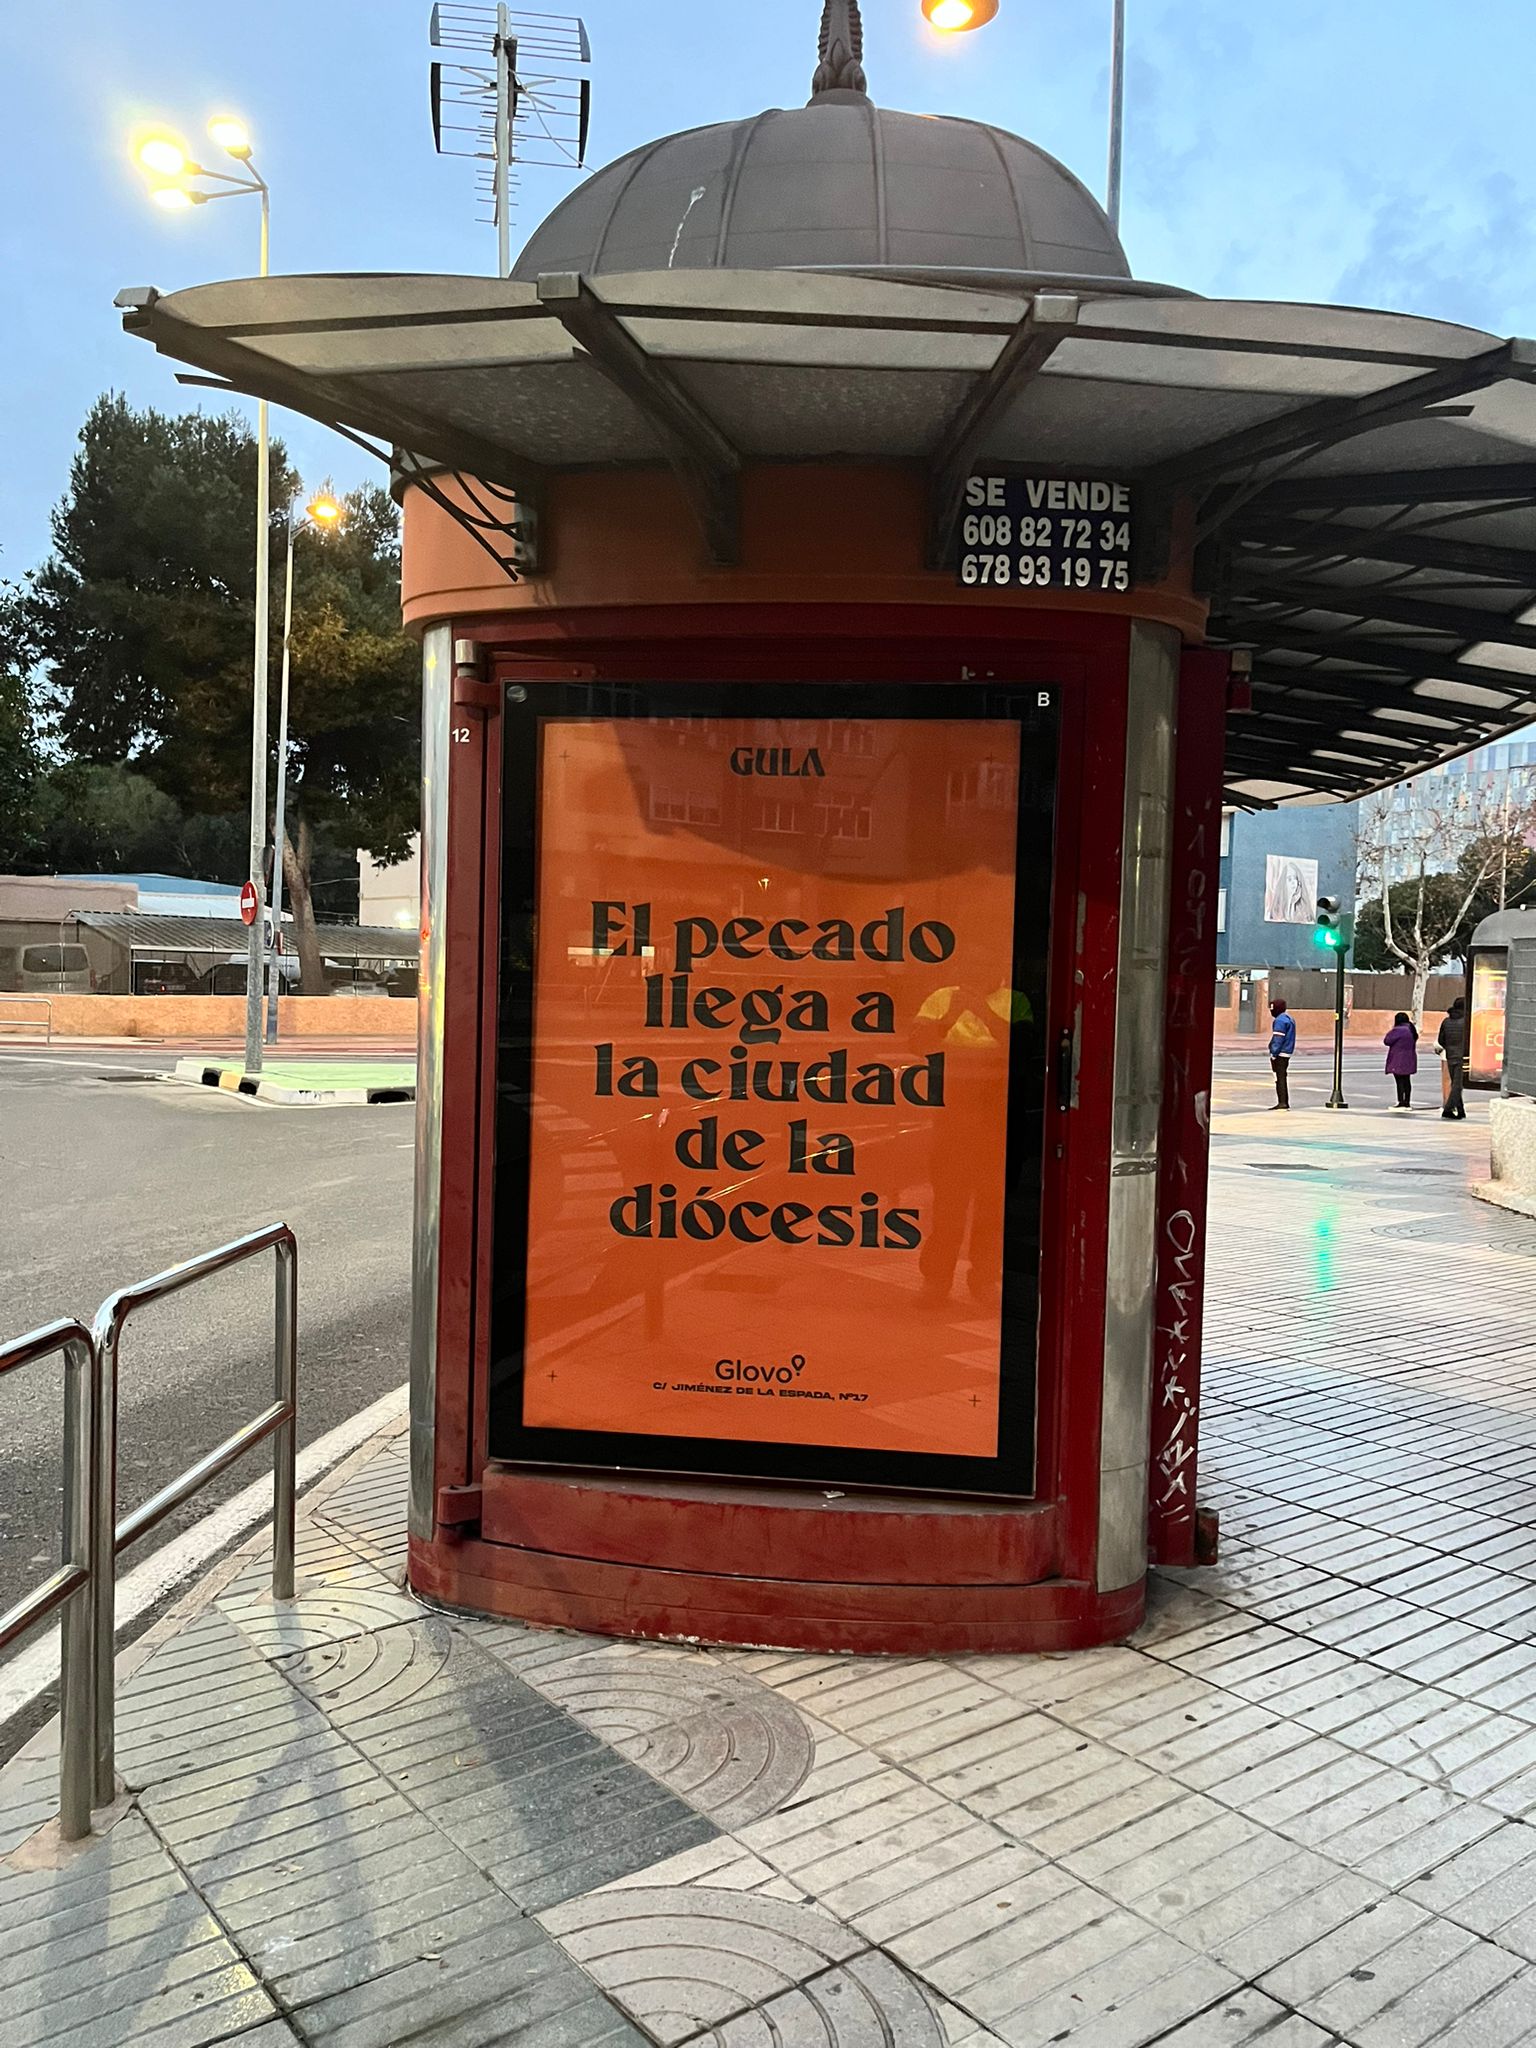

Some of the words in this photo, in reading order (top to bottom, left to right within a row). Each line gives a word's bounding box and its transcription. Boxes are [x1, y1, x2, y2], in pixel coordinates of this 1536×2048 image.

[966, 476, 1006, 507] SE
[1026, 479, 1131, 513] VENDE
[963, 515, 1012, 547] 608
[1020, 516, 1052, 548] 82
[1061, 518, 1092, 549] 72
[1100, 521, 1131, 552] 34
[961, 554, 1010, 585] 678
[1019, 555, 1051, 586] 93
[1061, 558, 1091, 588] 19
[1099, 560, 1130, 592] 75
[1037, 691, 1050, 707] B
[451, 727, 471, 743] 12
[730, 747, 826, 777] GULA
[591, 901, 651, 957] El
[673, 906, 956, 973] pecado
[644, 973, 830, 1045] llega
[850, 990, 896, 1034] a
[594, 1042, 660, 1098] la
[680, 1045, 946, 1107] ciudad
[674, 1115, 766, 1172] de
[787, 1118, 856, 1176] la
[609, 1183, 922, 1250] diócesis
[715, 1358, 793, 1384] Glovo
[652, 1382, 667, 1390] C/
[671, 1382, 733, 1394] JIMÉNEZ
[736, 1386, 754, 1395] DE
[757, 1388, 775, 1397] LA
[779, 1389, 835, 1401] ESPADA,
